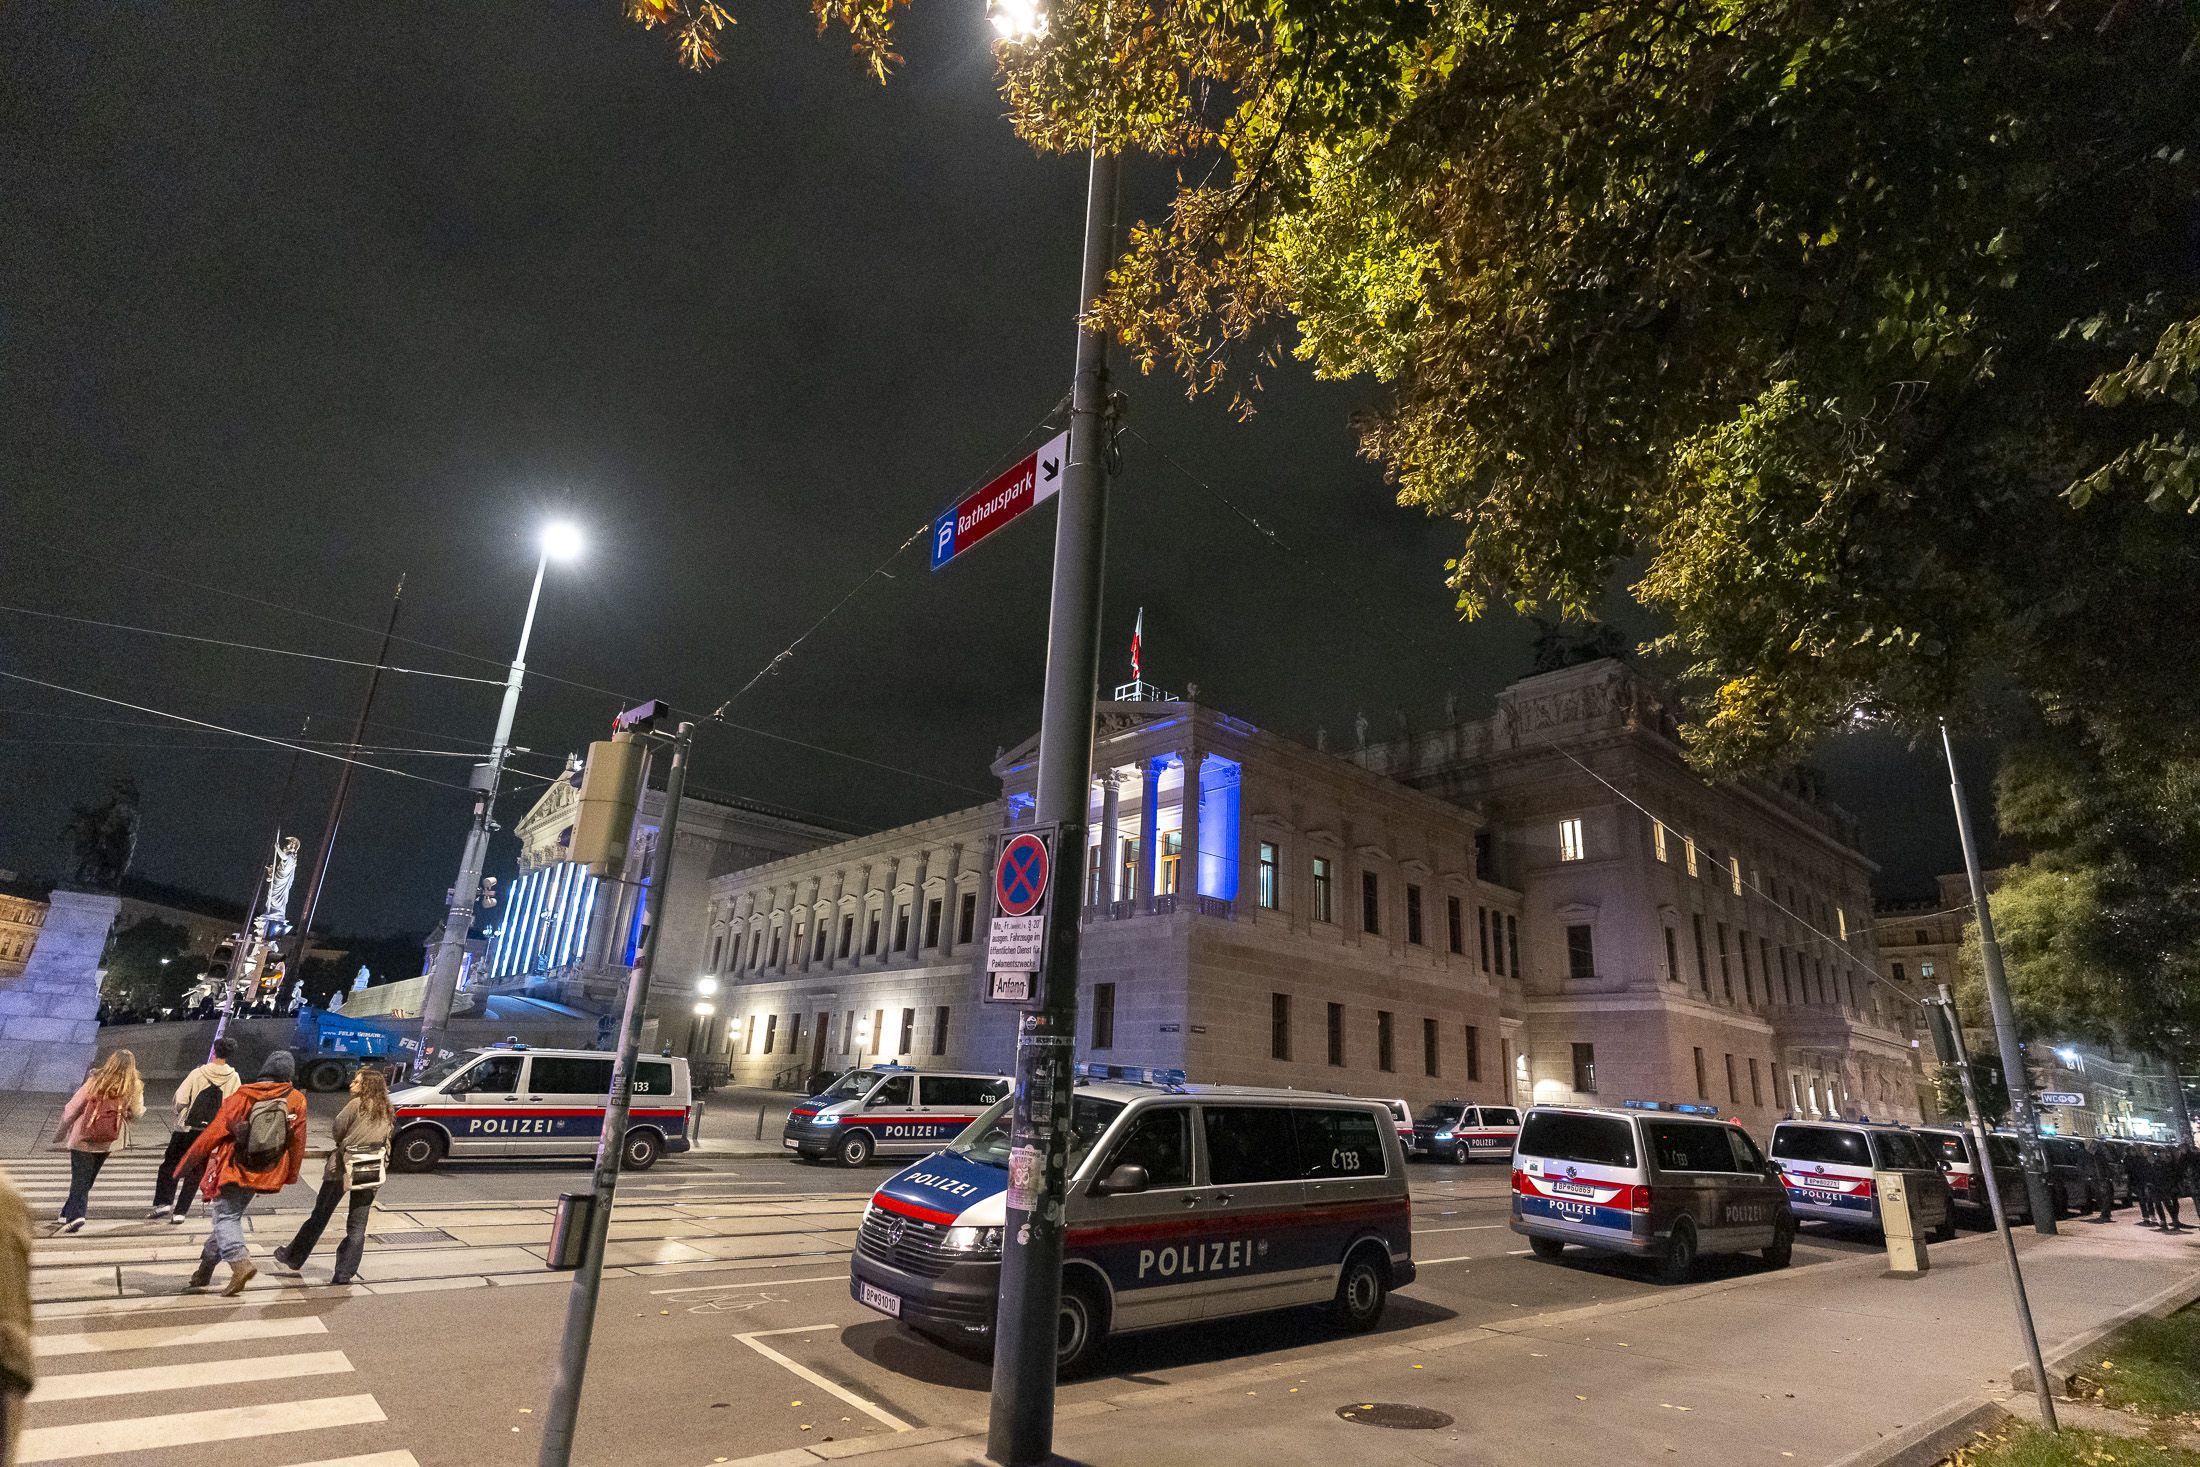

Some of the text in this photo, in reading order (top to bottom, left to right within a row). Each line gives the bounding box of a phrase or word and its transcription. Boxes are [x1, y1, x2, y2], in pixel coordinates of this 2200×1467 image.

[957, 471, 1034, 536] Rathauspark
[1010, 932, 1033, 943] Fahrzeuge
[1034, 932, 1040, 941] im
[990, 945, 1016, 955] öffentlichen
[1016, 945, 1032, 955] Dienst
[633, 1081, 649, 1092] 133
[985, 1094, 996, 1104] 133
[2043, 1095, 2058, 1103] WC
[469, 1119, 553, 1133] POLIZEI
[885, 1125, 937, 1137] POLIZEI
[1472, 1138, 1495, 1147] POLIZEI
[1340, 1151, 1360, 1170] 133
[904, 1172, 979, 1198] POLIZEI
[1802, 1190, 1842, 1201] POLIZEI
[1549, 1200, 1597, 1216] POLIZEI
[1726, 1206, 1762, 1223] POLIZEI
[1138, 1239, 1253, 1279] POLIZEI
